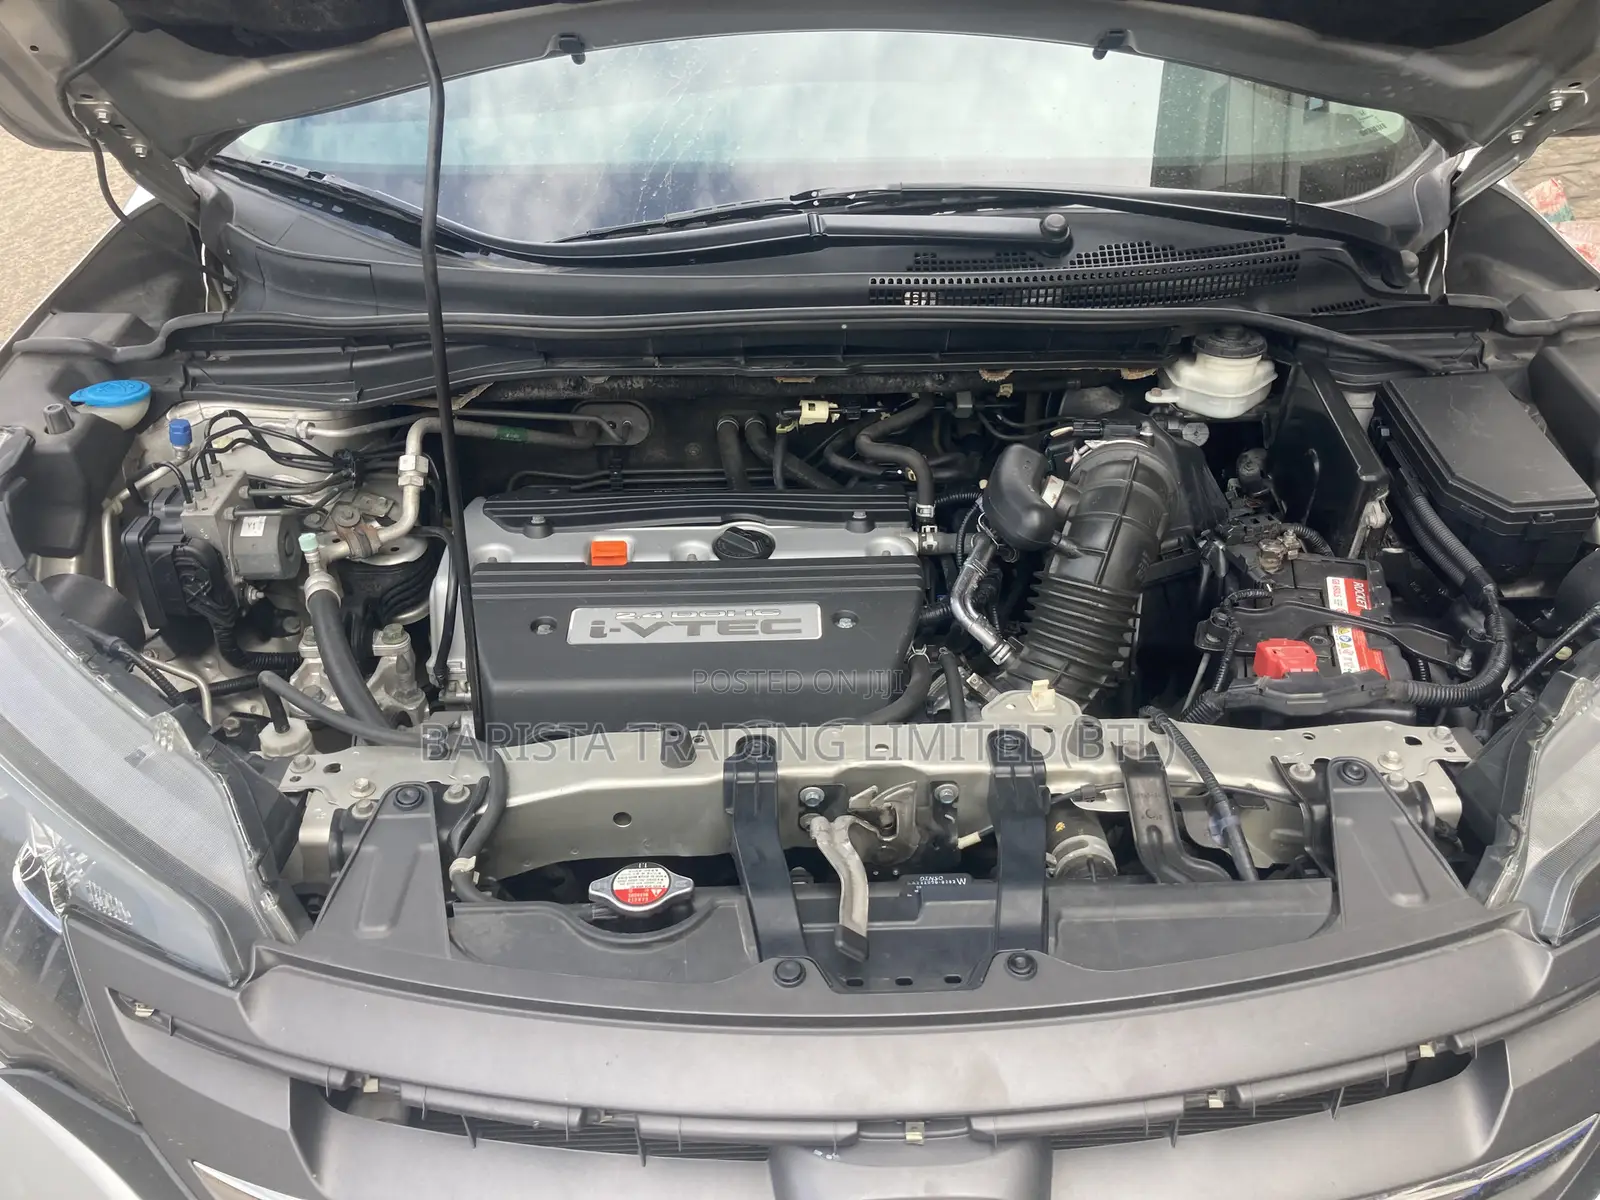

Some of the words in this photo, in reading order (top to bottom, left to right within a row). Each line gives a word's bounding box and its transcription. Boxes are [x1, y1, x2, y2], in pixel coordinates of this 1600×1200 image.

[1353, 581, 1367, 609] ROCKET
[615, 610, 664, 620] 2.4
[670, 608, 782, 618] DOHC
[589, 617, 802, 638] i-VTEC
